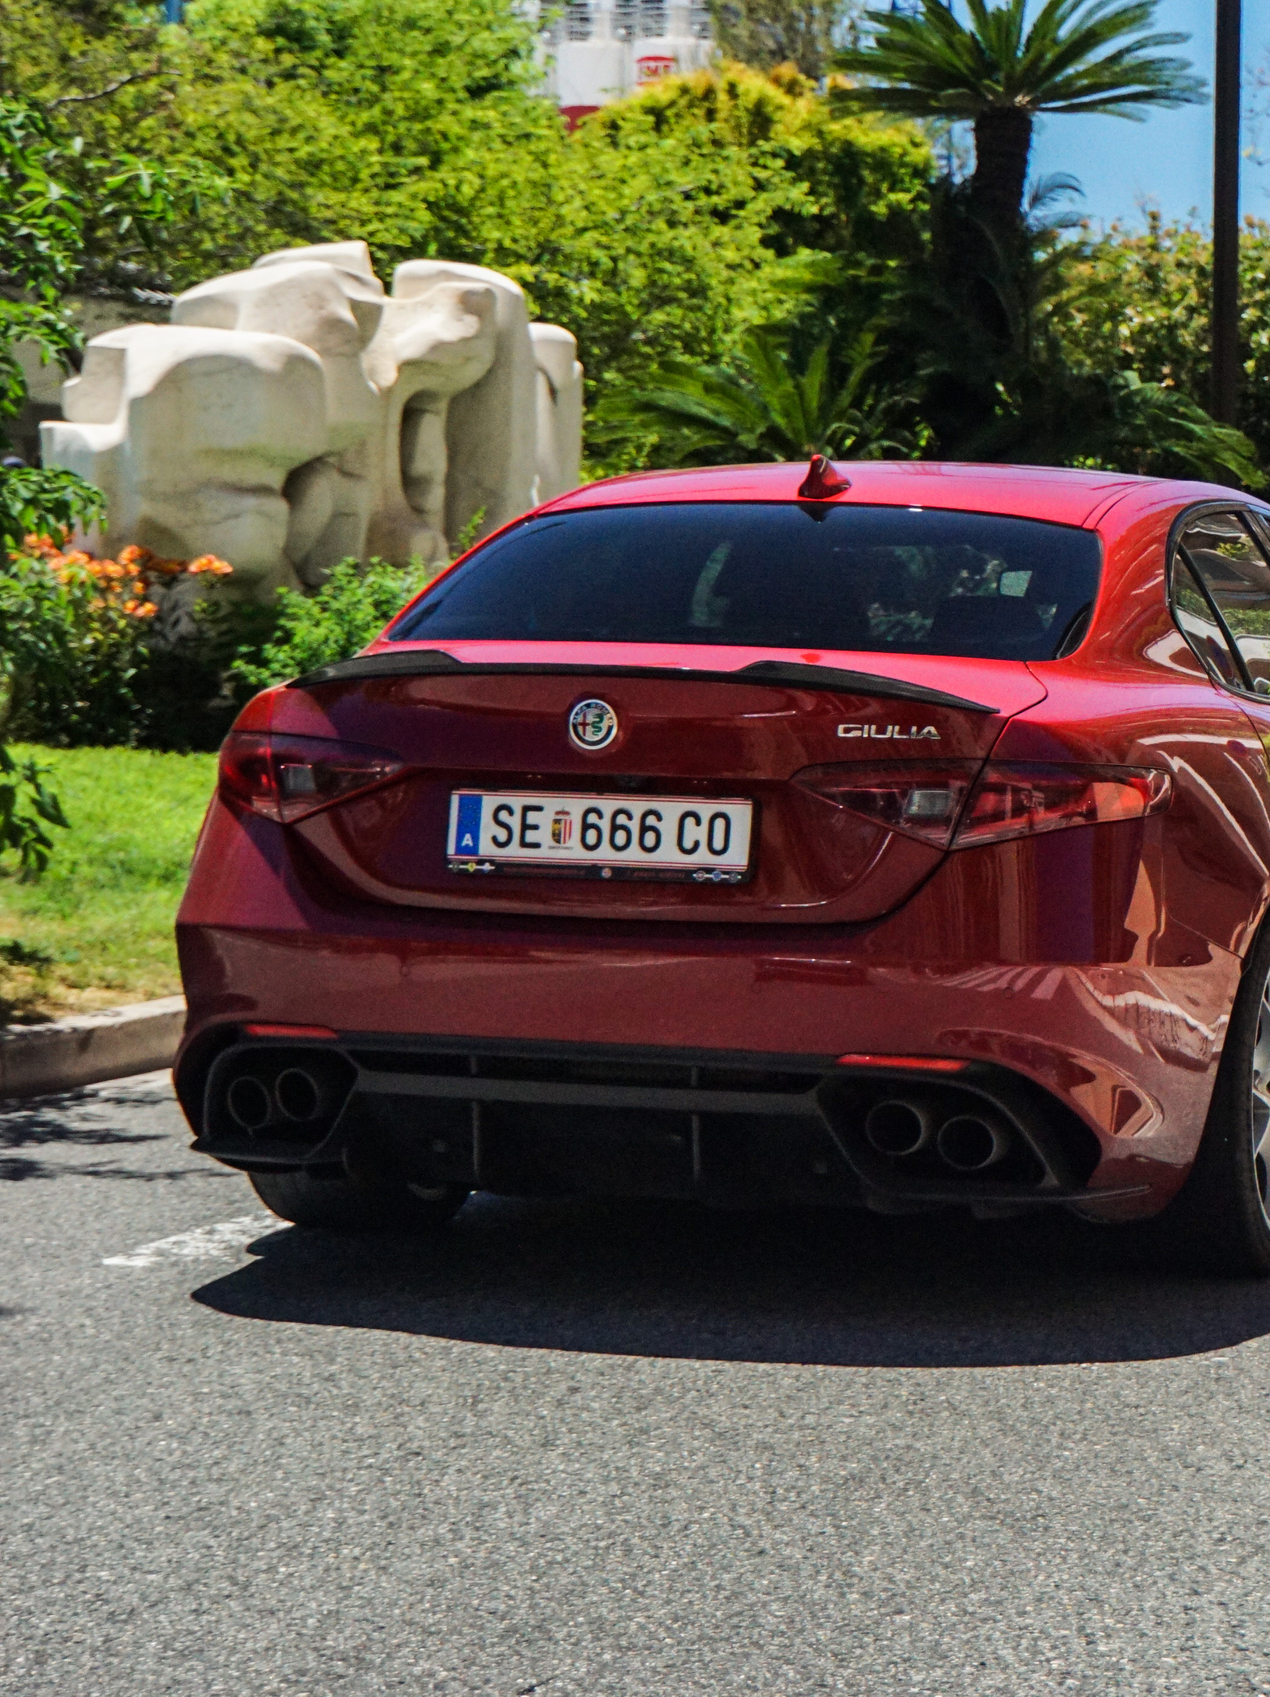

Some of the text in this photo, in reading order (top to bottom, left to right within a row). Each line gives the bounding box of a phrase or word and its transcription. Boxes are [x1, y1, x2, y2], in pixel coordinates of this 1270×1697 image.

[837, 724, 941, 740] GIULIA
[491, 803, 544, 849] SE
[580, 806, 664, 854] 666
[461, 833, 474, 847] A
